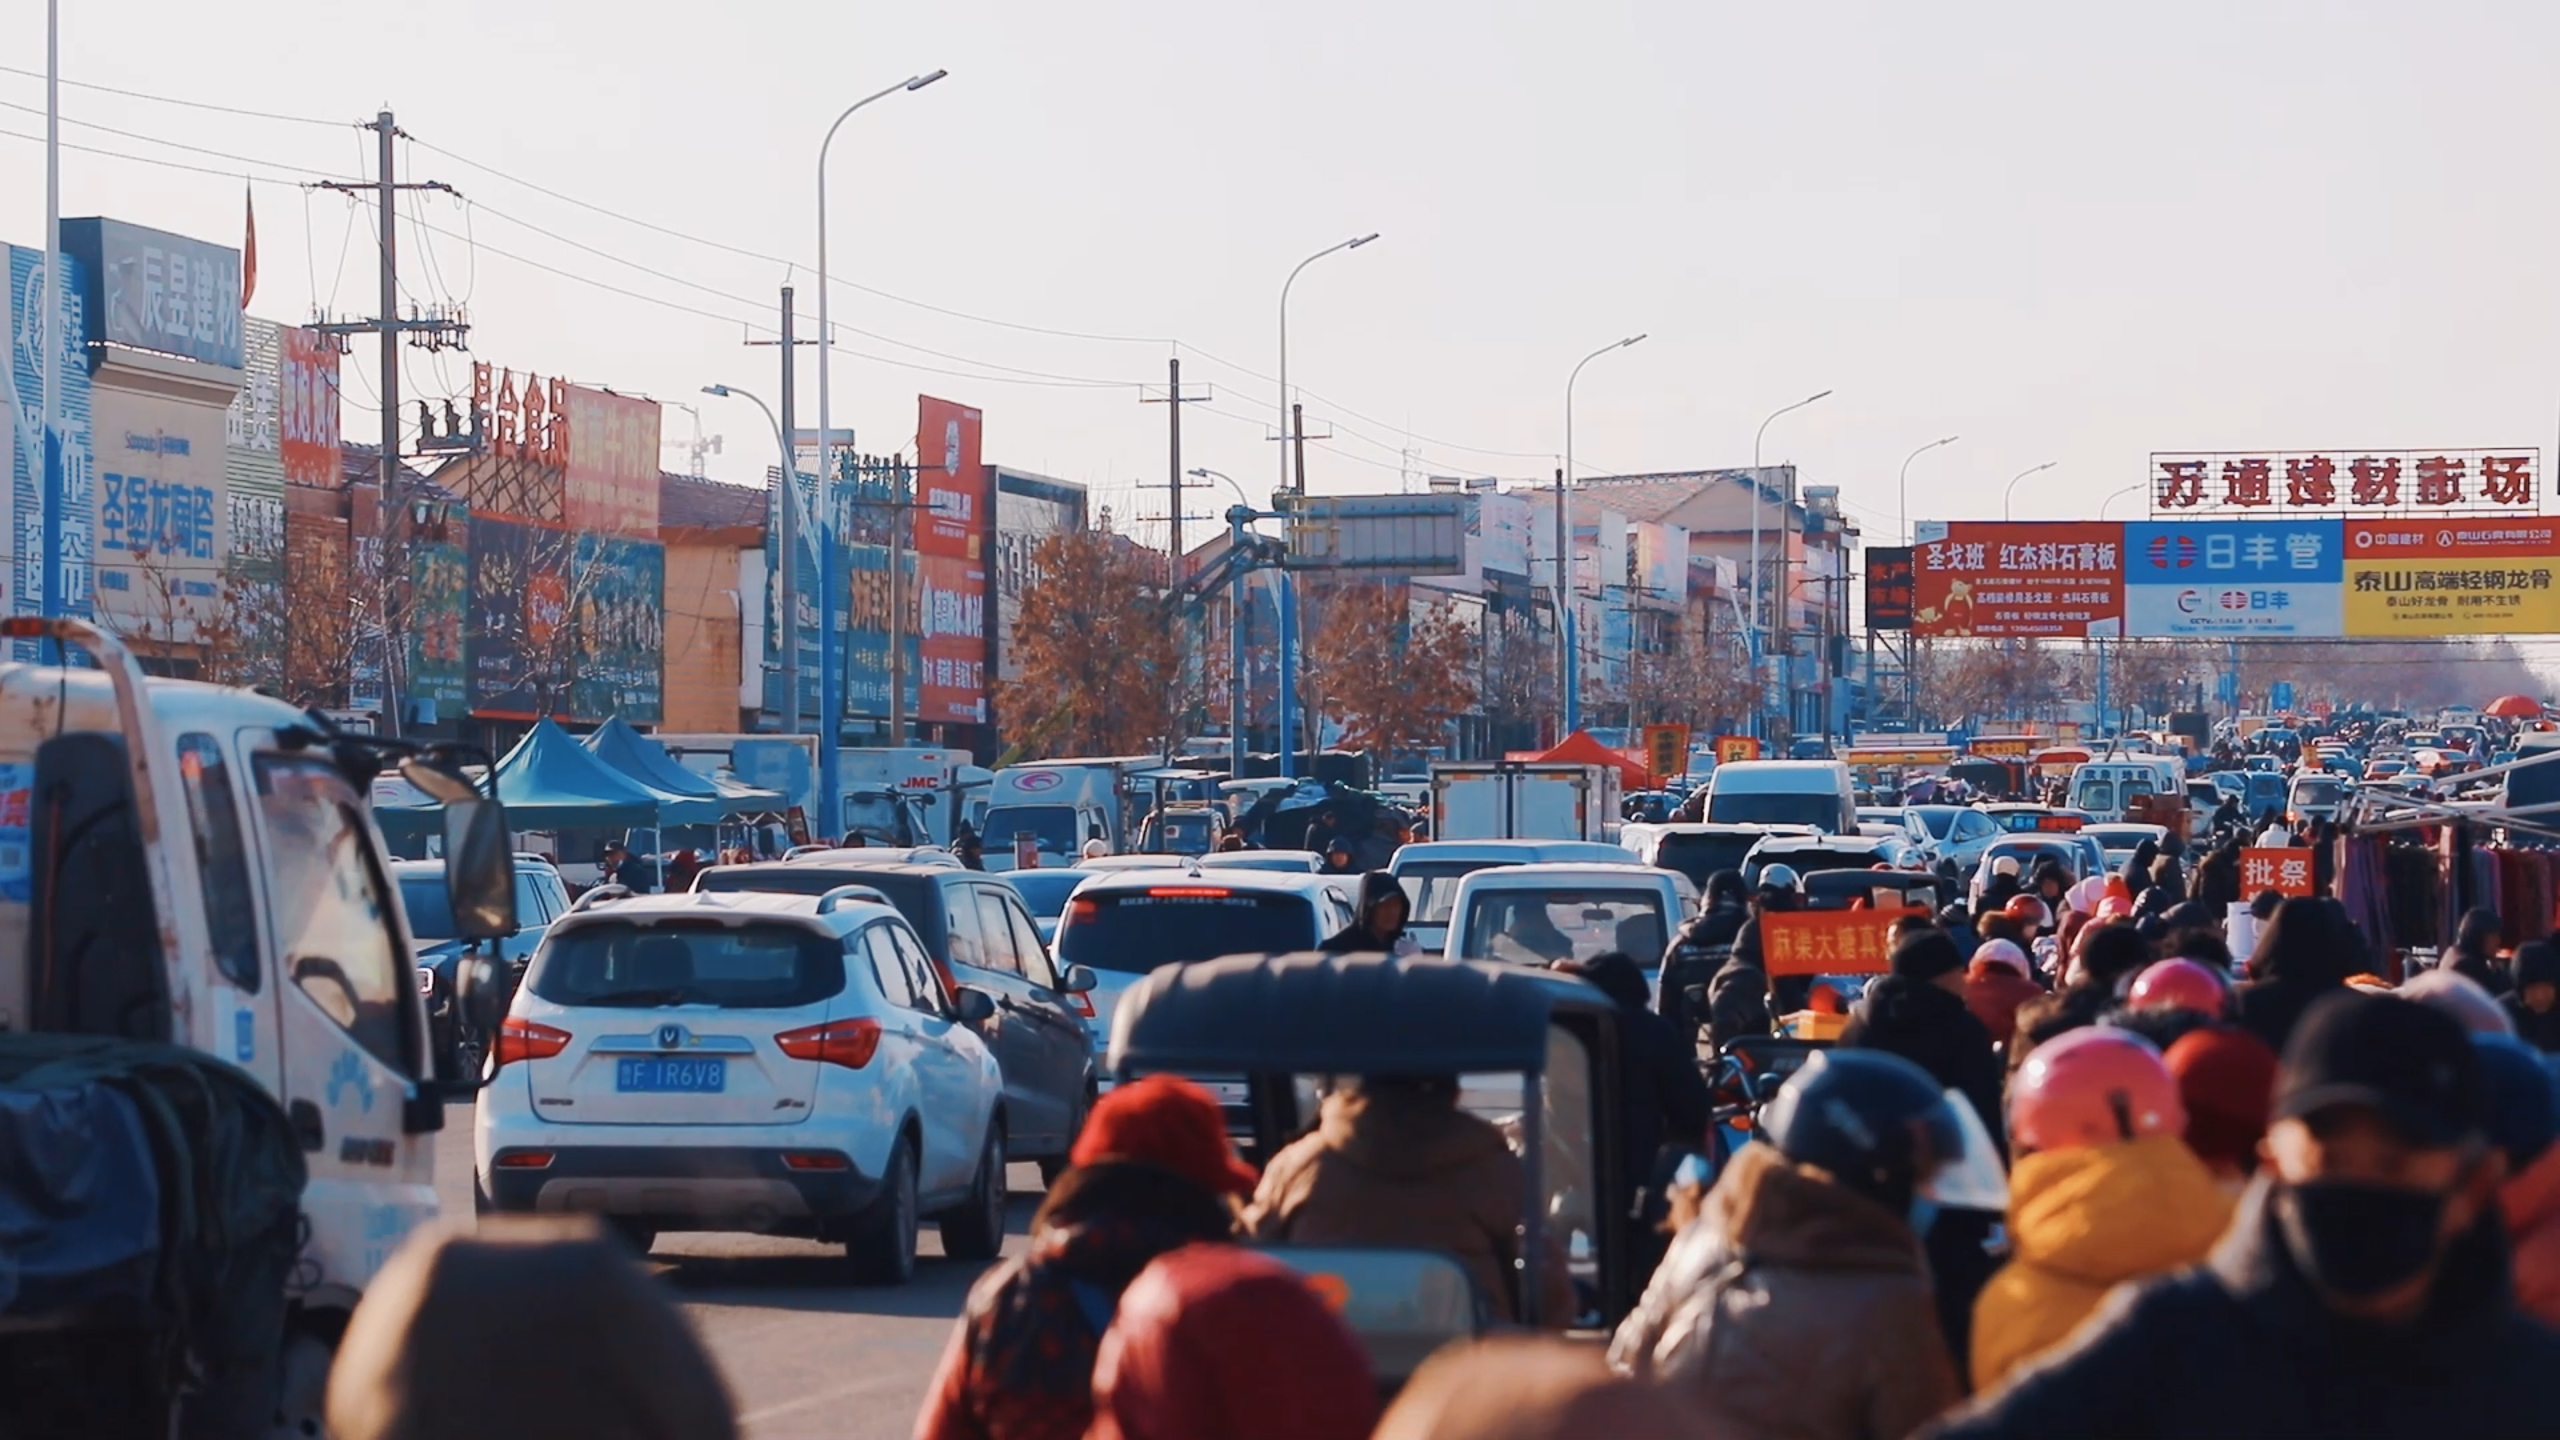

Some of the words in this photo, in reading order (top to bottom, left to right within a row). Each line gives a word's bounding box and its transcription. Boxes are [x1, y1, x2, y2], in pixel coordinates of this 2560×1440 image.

[140, 246, 239, 350] 辰昱建材
[102, 472, 215, 560] 圣堡龙陶瓷
[2206, 533, 2323, 570] 日丰管
[2375, 533, 2424, 545] 中国建材
[1926, 543, 1985, 571] 圣戈班
[1999, 542, 2117, 571] 红杰科石膏板
[2354, 569, 2552, 592] 泰山高端轻钢龙骨
[2251, 591, 2290, 609] 日丰
[2386, 596, 2448, 607] 泰山好龙骨
[900, 777, 938, 788] JMC
[2245, 857, 2308, 887] 批祭
[1772, 925, 1891, 963] 麻渠大糖真
